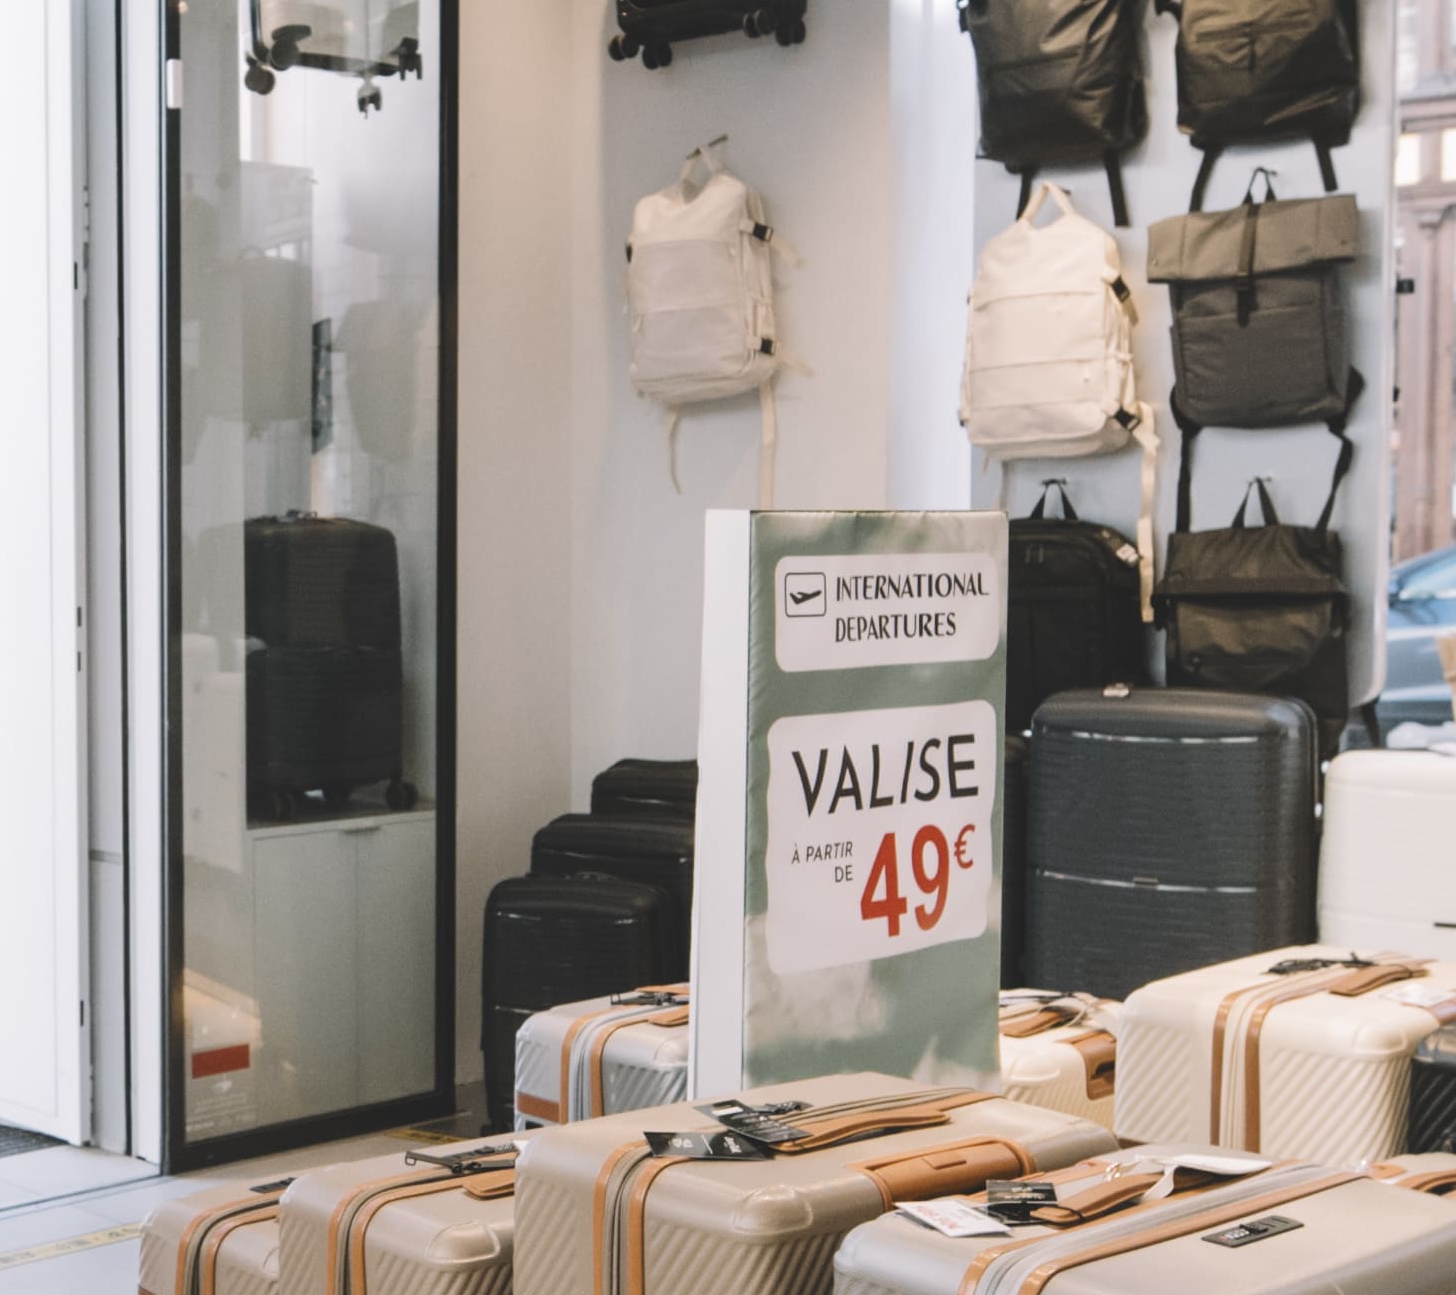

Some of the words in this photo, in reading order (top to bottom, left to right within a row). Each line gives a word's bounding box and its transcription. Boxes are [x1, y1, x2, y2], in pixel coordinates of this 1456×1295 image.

[835, 572, 990, 602] INTERNATIONAL
[834, 612, 957, 643] DEPARTURES
[791, 733, 979, 818] VALISE
[791, 842, 801, 865] À
[805, 840, 854, 863] PARTIR
[834, 865, 854, 884] DE
[860, 823, 976, 937] 49€
